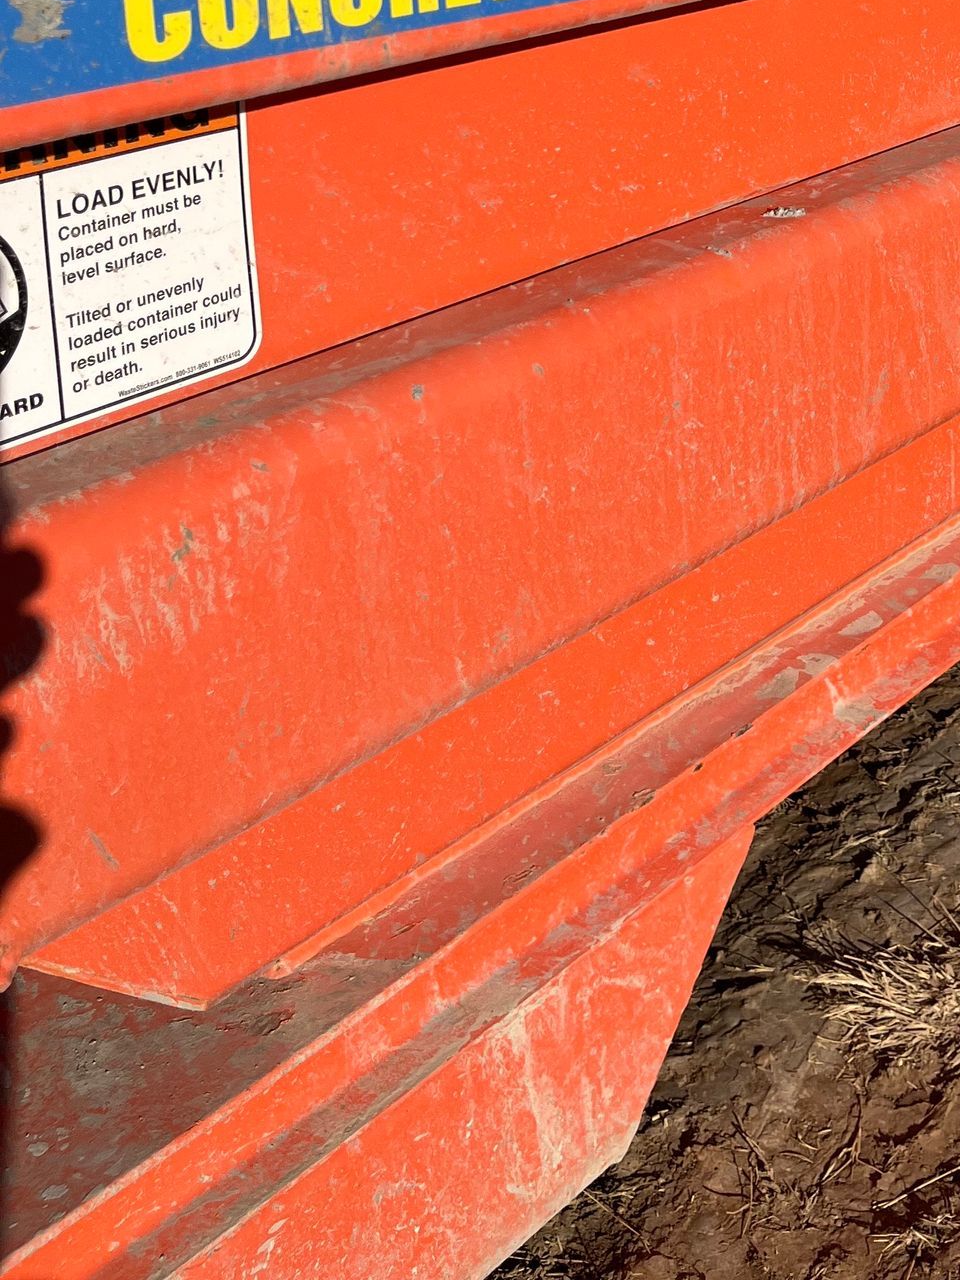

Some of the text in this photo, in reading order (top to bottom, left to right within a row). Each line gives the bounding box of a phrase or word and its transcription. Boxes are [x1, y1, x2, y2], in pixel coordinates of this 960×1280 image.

[56, 159, 225, 219] LOAD EVENLY!
[57, 193, 202, 242] Container must be
[60, 218, 182, 267] placed on hard,
[61, 247, 168, 286] level surface.
[65, 276, 205, 329] Tilted or unevenly
[68, 283, 243, 351] loaded container could
[70, 305, 241, 372] result in serious injury
[72, 359, 144, 395] or death.
[118, 373, 174, 398] WasteStickers.com
